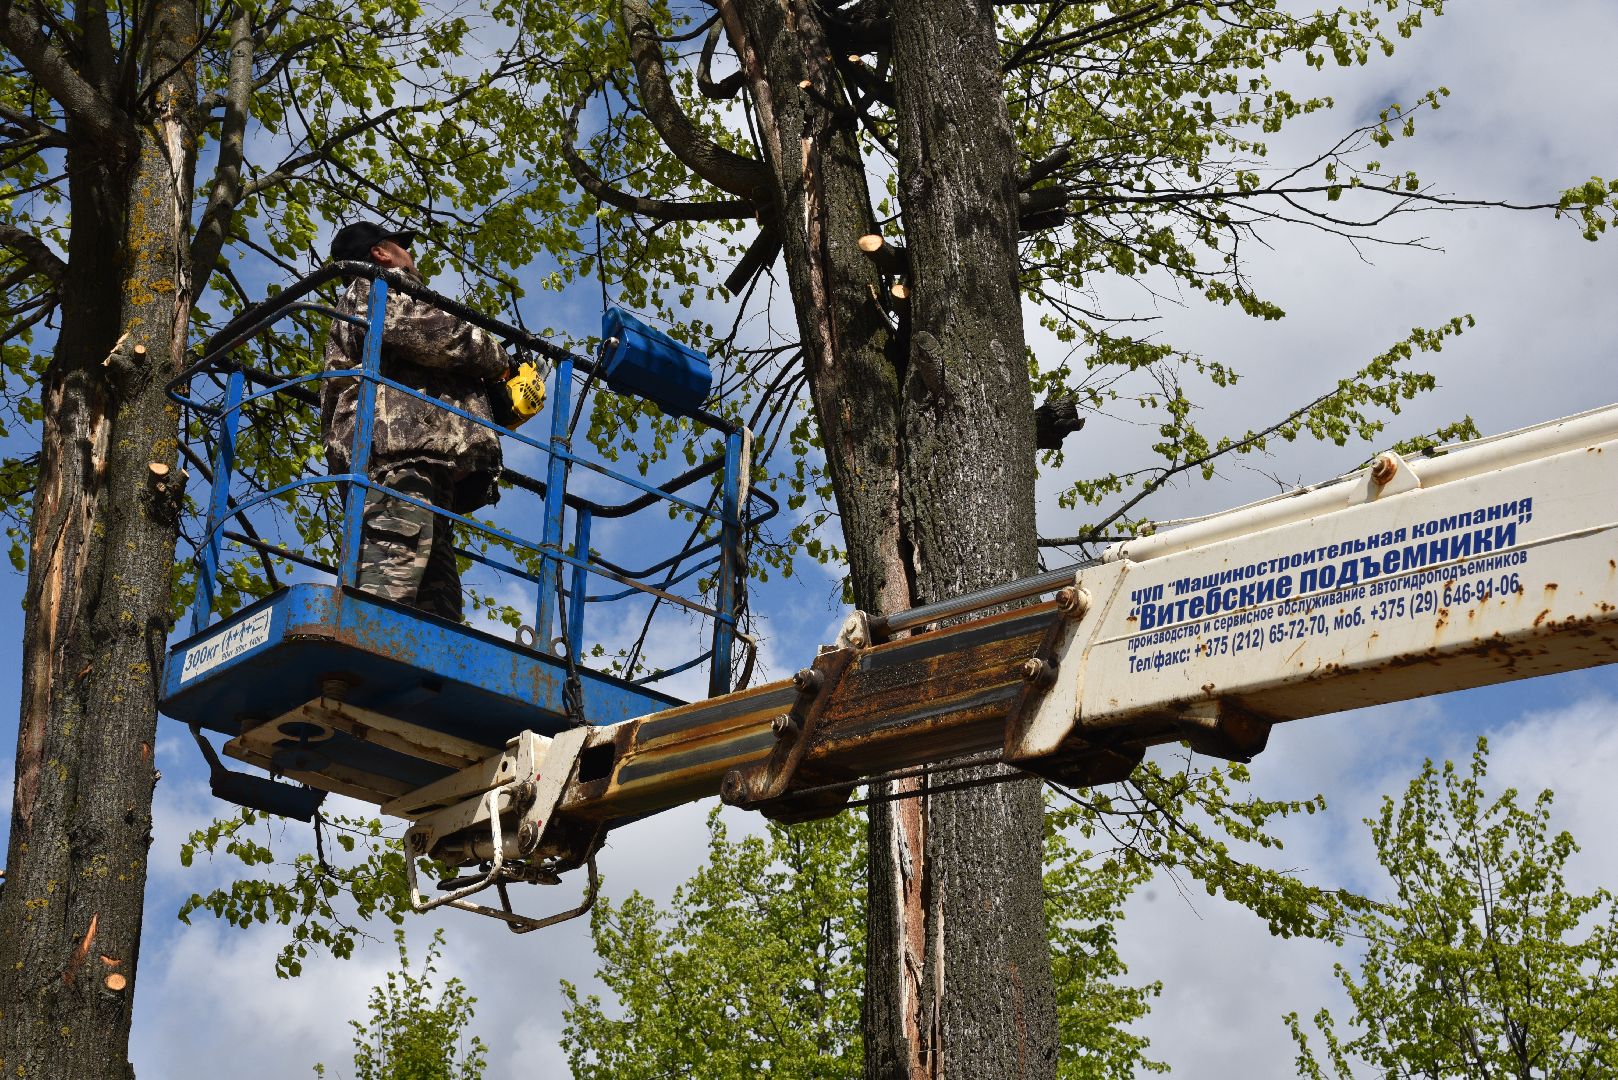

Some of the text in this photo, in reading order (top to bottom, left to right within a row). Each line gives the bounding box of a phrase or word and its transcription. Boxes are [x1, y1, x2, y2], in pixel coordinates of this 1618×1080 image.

[1411, 497, 1533, 540] компания
[1128, 550, 1528, 653] производство и сервисное обслуживание автогидроподъемников
[1128, 648, 1190, 674] Тел/факс:
[1232, 627, 1265, 657] (212)
[1269, 615, 1329, 644] 65-72-70,
[1370, 596, 1405, 622] +375
[1409, 589, 1439, 619] (29)
[1443, 572, 1520, 608] 646-91-06
